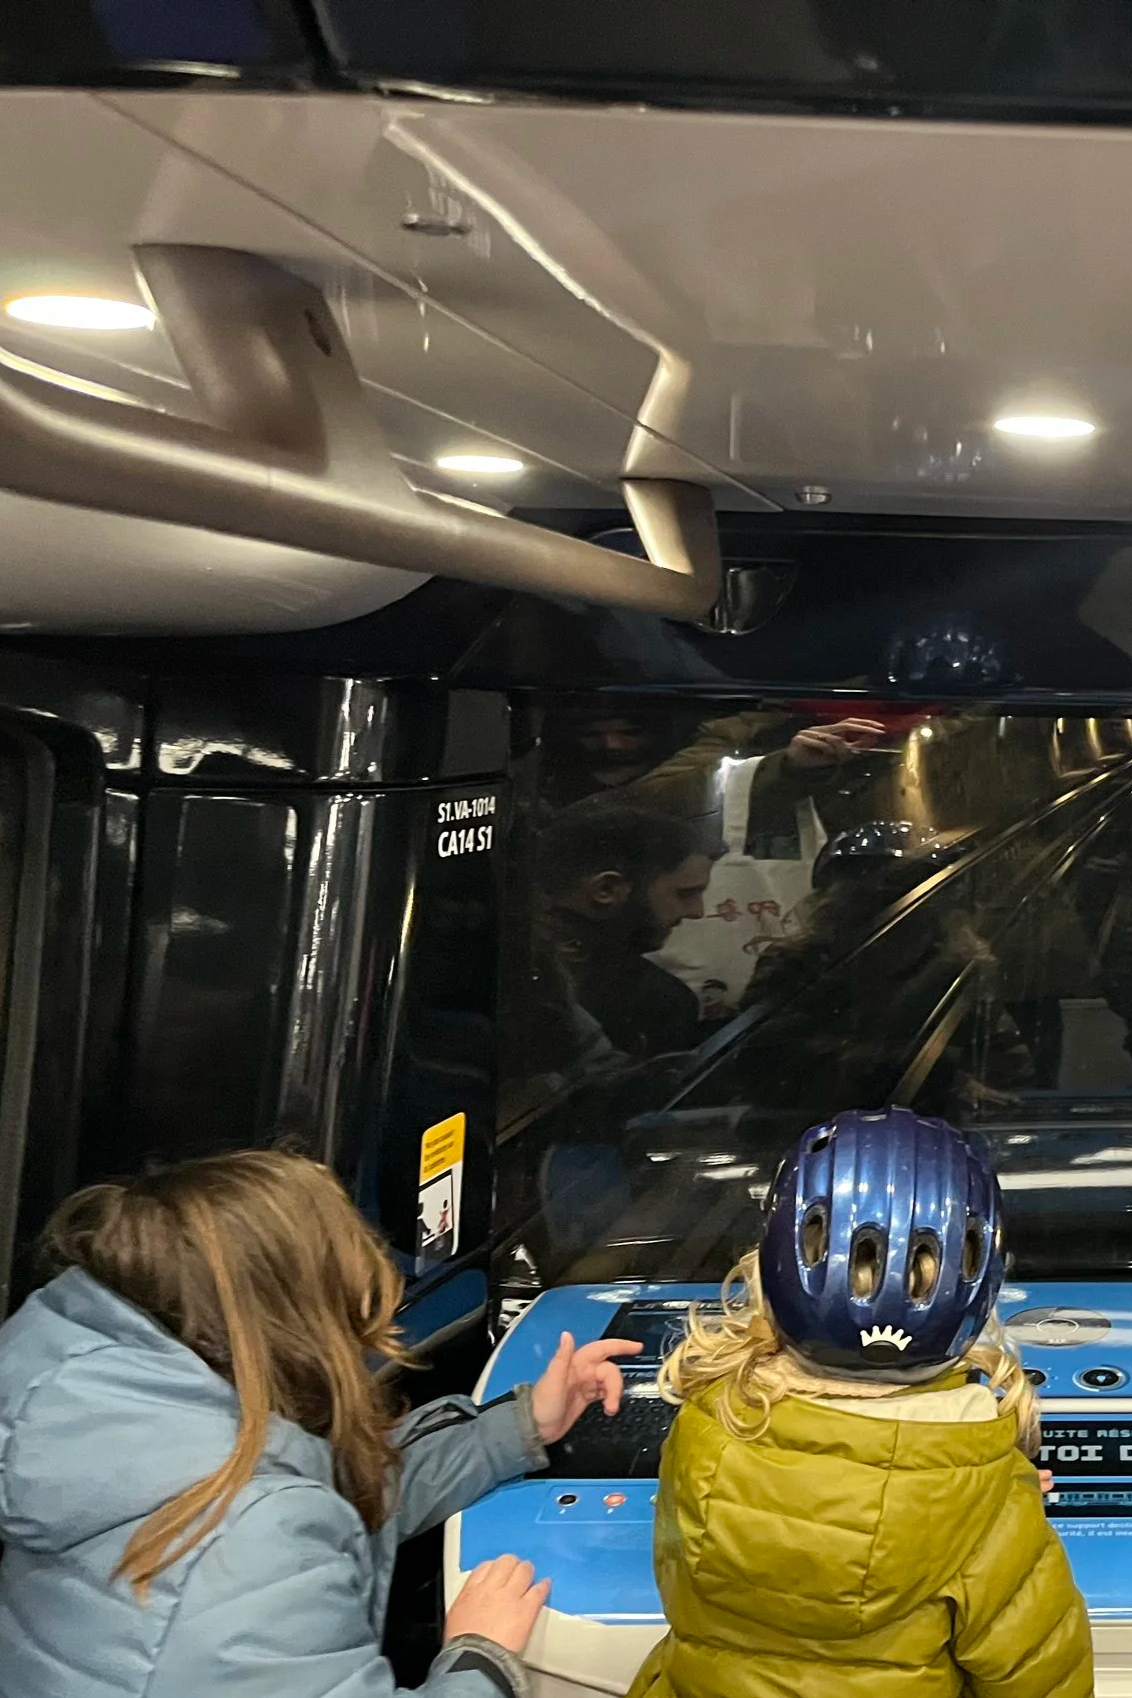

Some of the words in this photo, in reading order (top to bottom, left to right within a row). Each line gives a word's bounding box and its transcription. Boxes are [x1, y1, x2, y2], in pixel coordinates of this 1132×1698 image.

[437, 796, 496, 823] S1.VA-1014
[437, 828, 475, 858] CA14
[476, 825, 493, 852] S1
[1042, 1429, 1088, 1438] UITE
[1039, 1445, 1103, 1462] TOI
